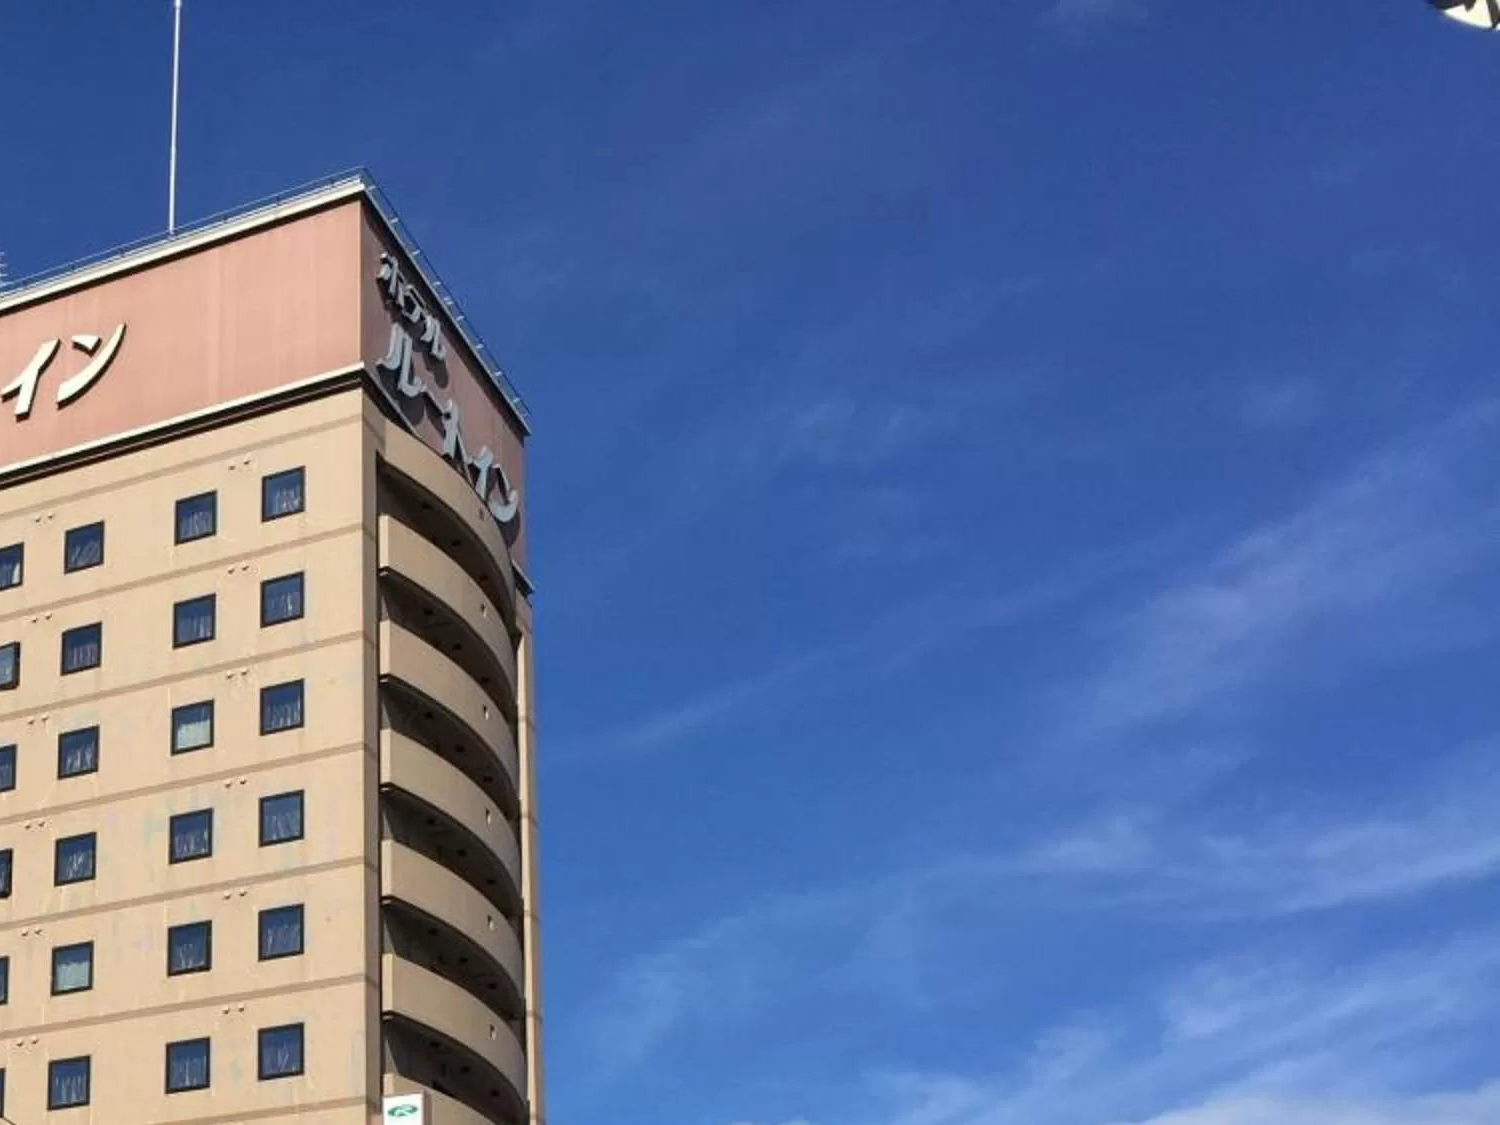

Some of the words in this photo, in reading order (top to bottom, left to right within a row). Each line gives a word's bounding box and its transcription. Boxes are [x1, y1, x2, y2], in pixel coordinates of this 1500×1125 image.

[377, 252, 446, 361] ホテル
[376, 322, 518, 524] ルートイン
